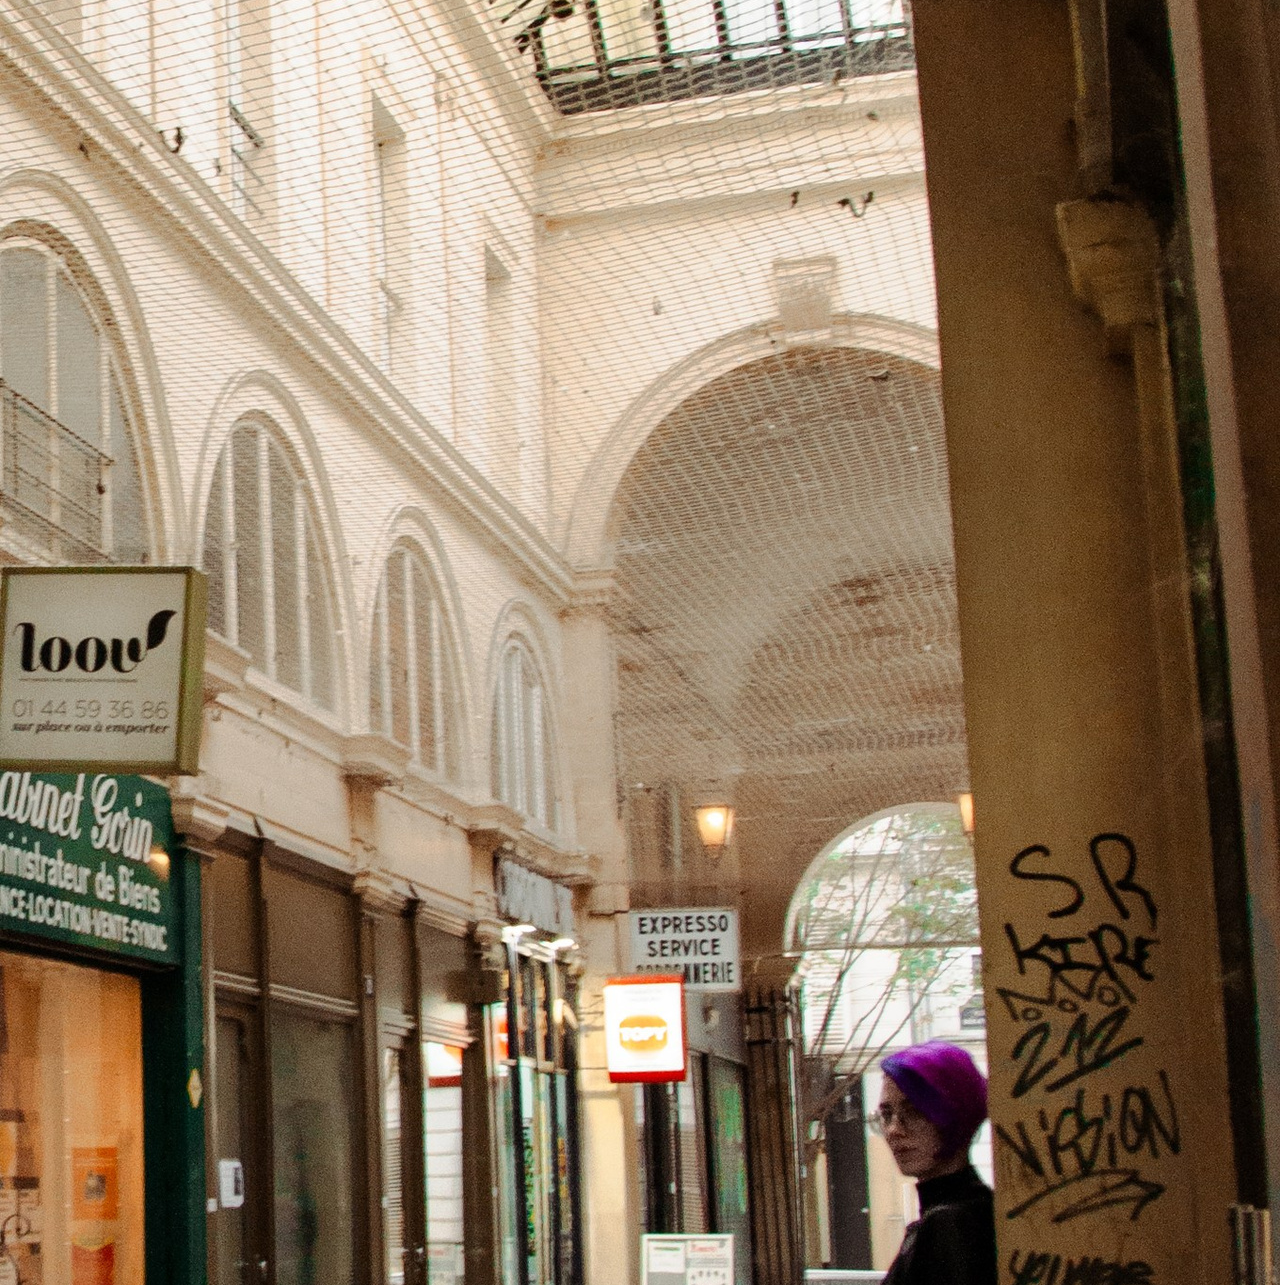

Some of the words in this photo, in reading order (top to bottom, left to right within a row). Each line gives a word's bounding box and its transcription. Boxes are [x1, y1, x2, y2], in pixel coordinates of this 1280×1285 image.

[12, 699, 34, 718] 01
[40, 699, 68, 715] 44
[75, 699, 102, 718] 59
[108, 700, 135, 719] 36
[141, 700, 169, 720] 86
[11, 722, 35, 733] sur
[34, 720, 72, 735] place
[73, 723, 92, 733] ou
[105, 722, 171, 735] emporter
[91, 774, 153, 863] Gorin
[95, 862, 116, 902] de
[118, 865, 161, 914] Biens
[638, 915, 729, 934] EXPRESSO
[647, 939, 721, 957] SERVICE
[620, 1026, 668, 1042] TOPY
